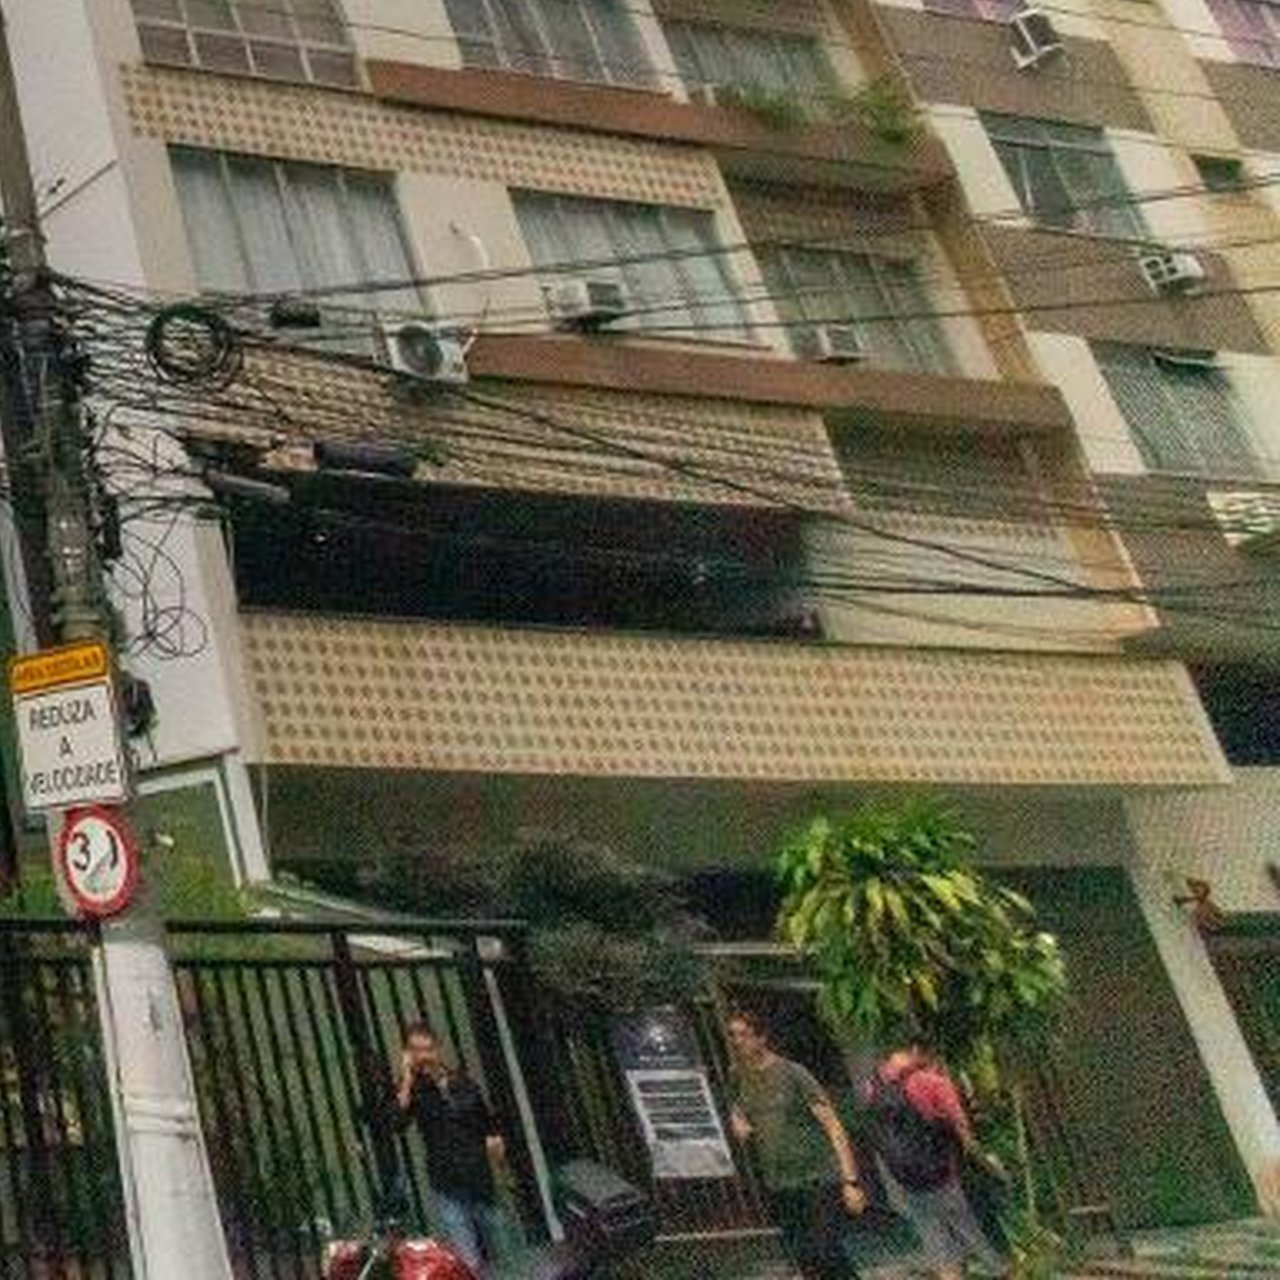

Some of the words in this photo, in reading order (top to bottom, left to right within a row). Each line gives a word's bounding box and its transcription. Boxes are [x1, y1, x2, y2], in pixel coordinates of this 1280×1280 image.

[29, 699, 98, 731] REDUZA
[59, 736, 74, 758] A
[28, 759, 117, 795] VELOCIDADE
